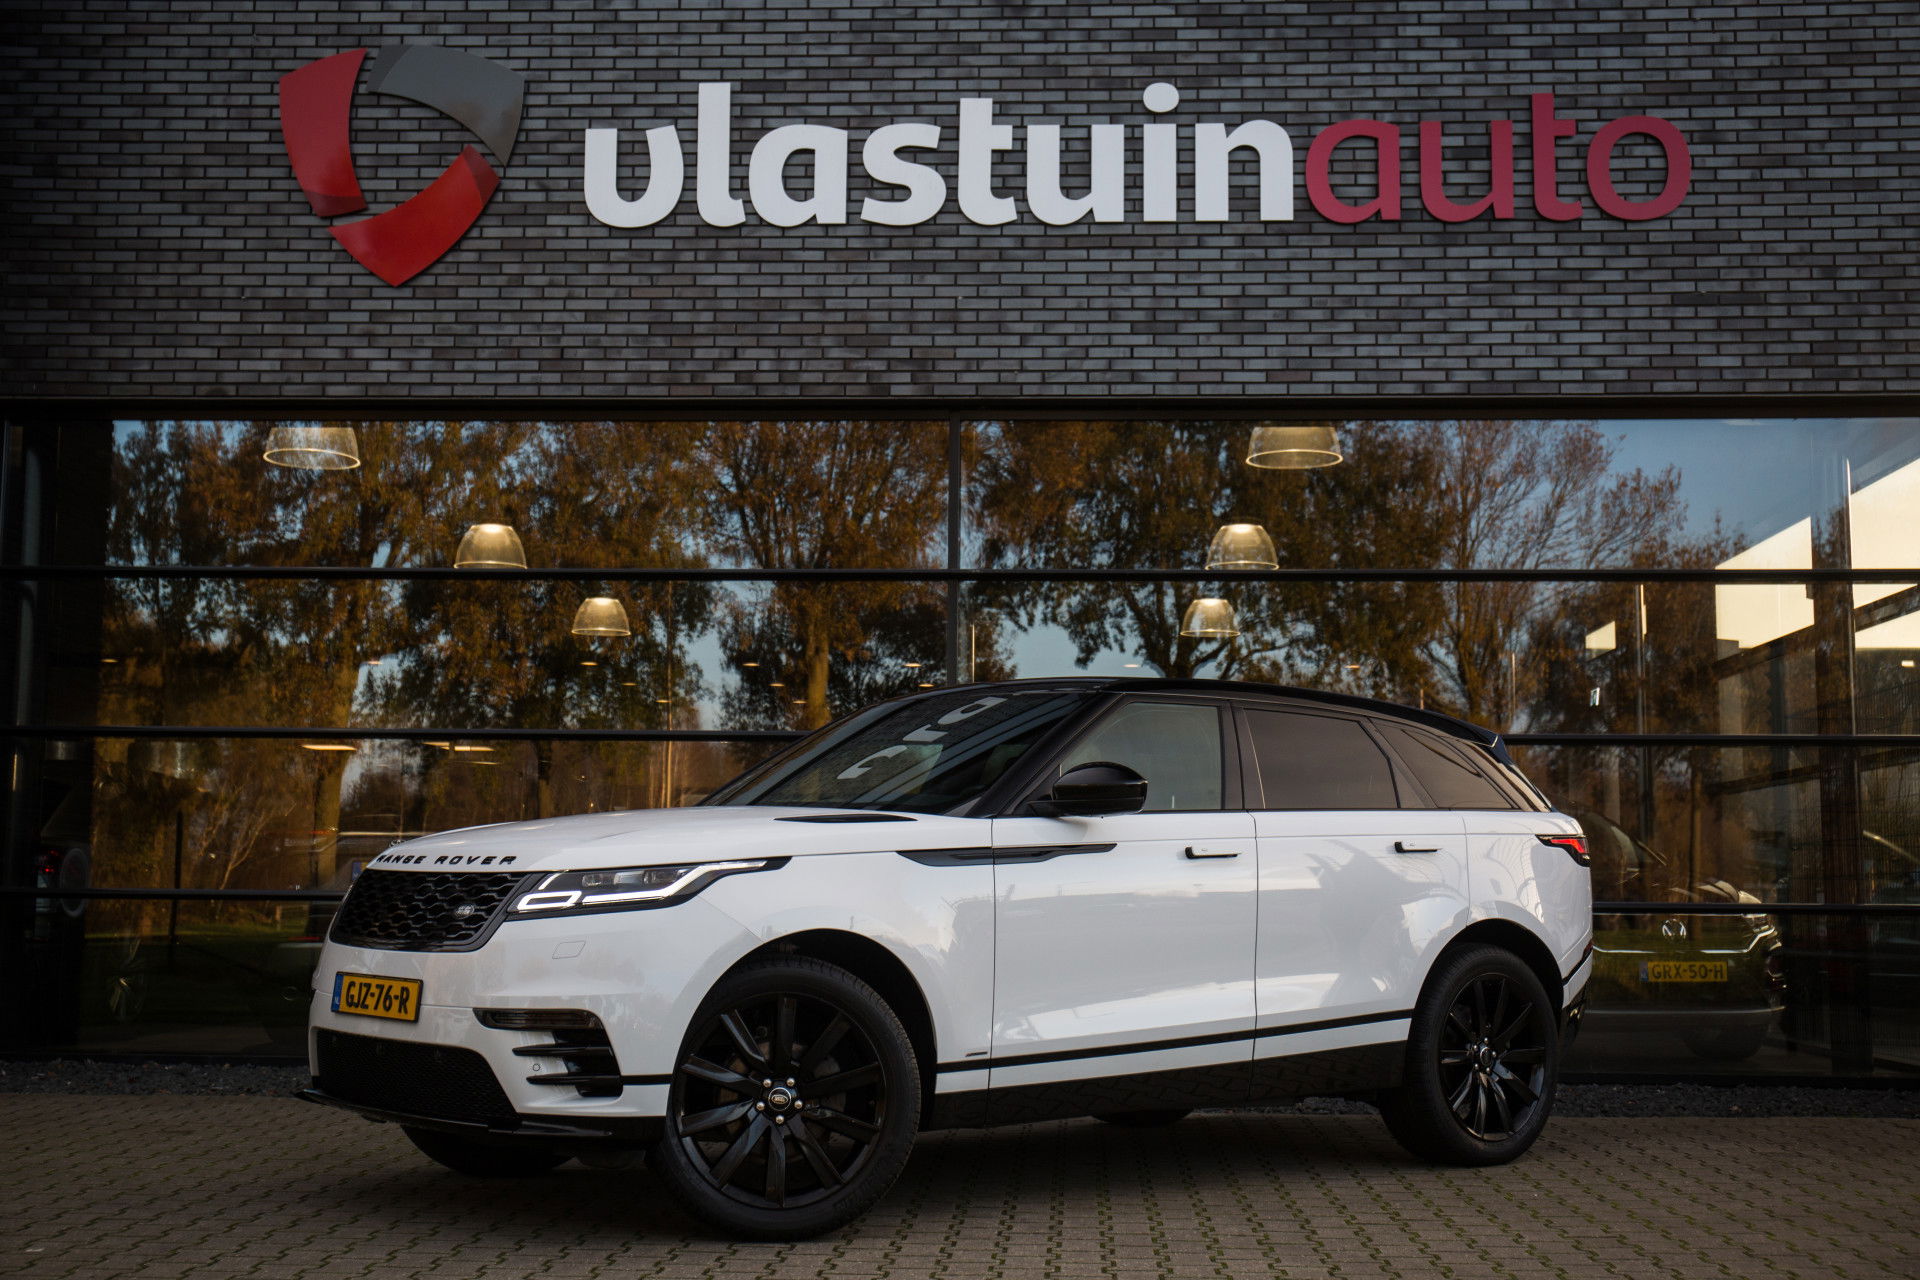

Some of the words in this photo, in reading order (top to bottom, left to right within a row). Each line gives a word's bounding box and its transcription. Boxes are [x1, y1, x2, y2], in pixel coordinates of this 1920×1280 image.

[376, 854, 427, 865] RANGE
[434, 855, 517, 865] ROVER
[1651, 963, 1724, 979] GRX-50-H
[345, 980, 410, 1015] GJZ-76-R
